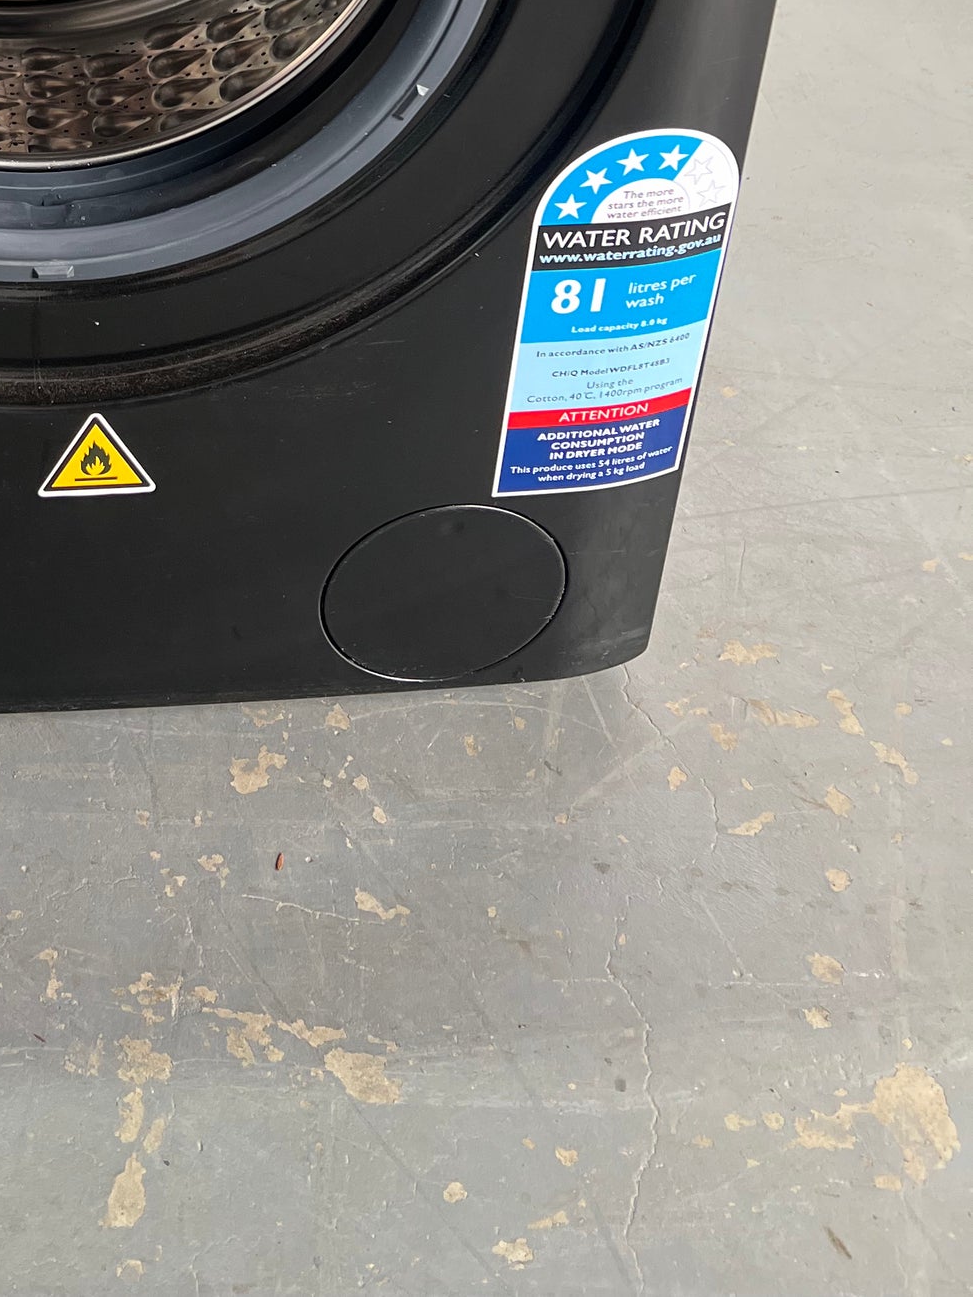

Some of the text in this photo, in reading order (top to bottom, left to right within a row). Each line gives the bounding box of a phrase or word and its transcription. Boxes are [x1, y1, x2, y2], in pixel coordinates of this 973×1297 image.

[608, 196, 684, 210] stars the more
[624, 188, 675, 200] The more
[607, 205, 682, 219] water efficient
[543, 212, 726, 249] WATER RATING
[539, 234, 722, 264] www.waterrating.gov.au
[628, 274, 697, 295] litres per
[625, 294, 664, 309] wash
[571, 324, 596, 333] Load
[598, 322, 639, 333] capacity
[656, 317, 668, 326] kg
[549, 348, 605, 357] accordance
[608, 345, 629, 354] with
[630, 339, 668, 351] AS/NZS
[580, 365, 608, 376] Model
[527, 395, 567, 404] Cotton,
[644, 377, 683, 393] program
[587, 378, 634, 390] Using the
[558, 402, 649, 423] ATTENTION
[537, 419, 660, 441] ADDITIONAL WATER
[551, 432, 645, 450] CONSUMPTION
[510, 446, 673, 474] This produce uses 54 litres of water
[549, 442, 643, 460] IN DRYER MODE
[537, 473, 563, 482] when
[567, 470, 597, 481] drying
[613, 467, 624, 476] kg
[626, 462, 645, 472] load
